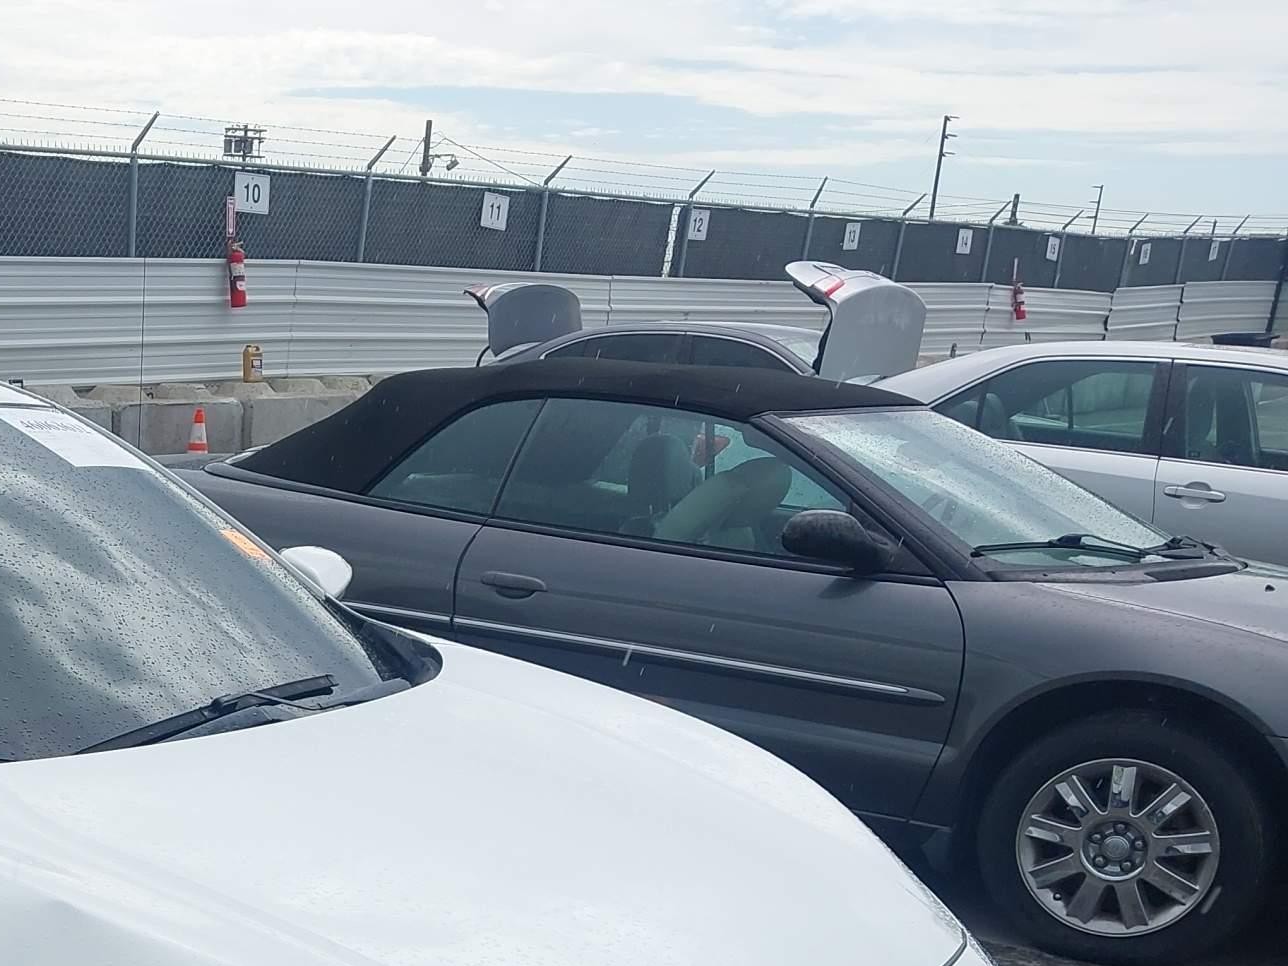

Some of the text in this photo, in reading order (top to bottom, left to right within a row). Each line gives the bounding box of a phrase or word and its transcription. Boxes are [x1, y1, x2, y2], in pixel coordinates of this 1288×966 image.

[243, 182, 262, 203] 10
[489, 203, 502, 221] 11
[692, 217, 704, 233] 12
[847, 229, 856, 244] 13
